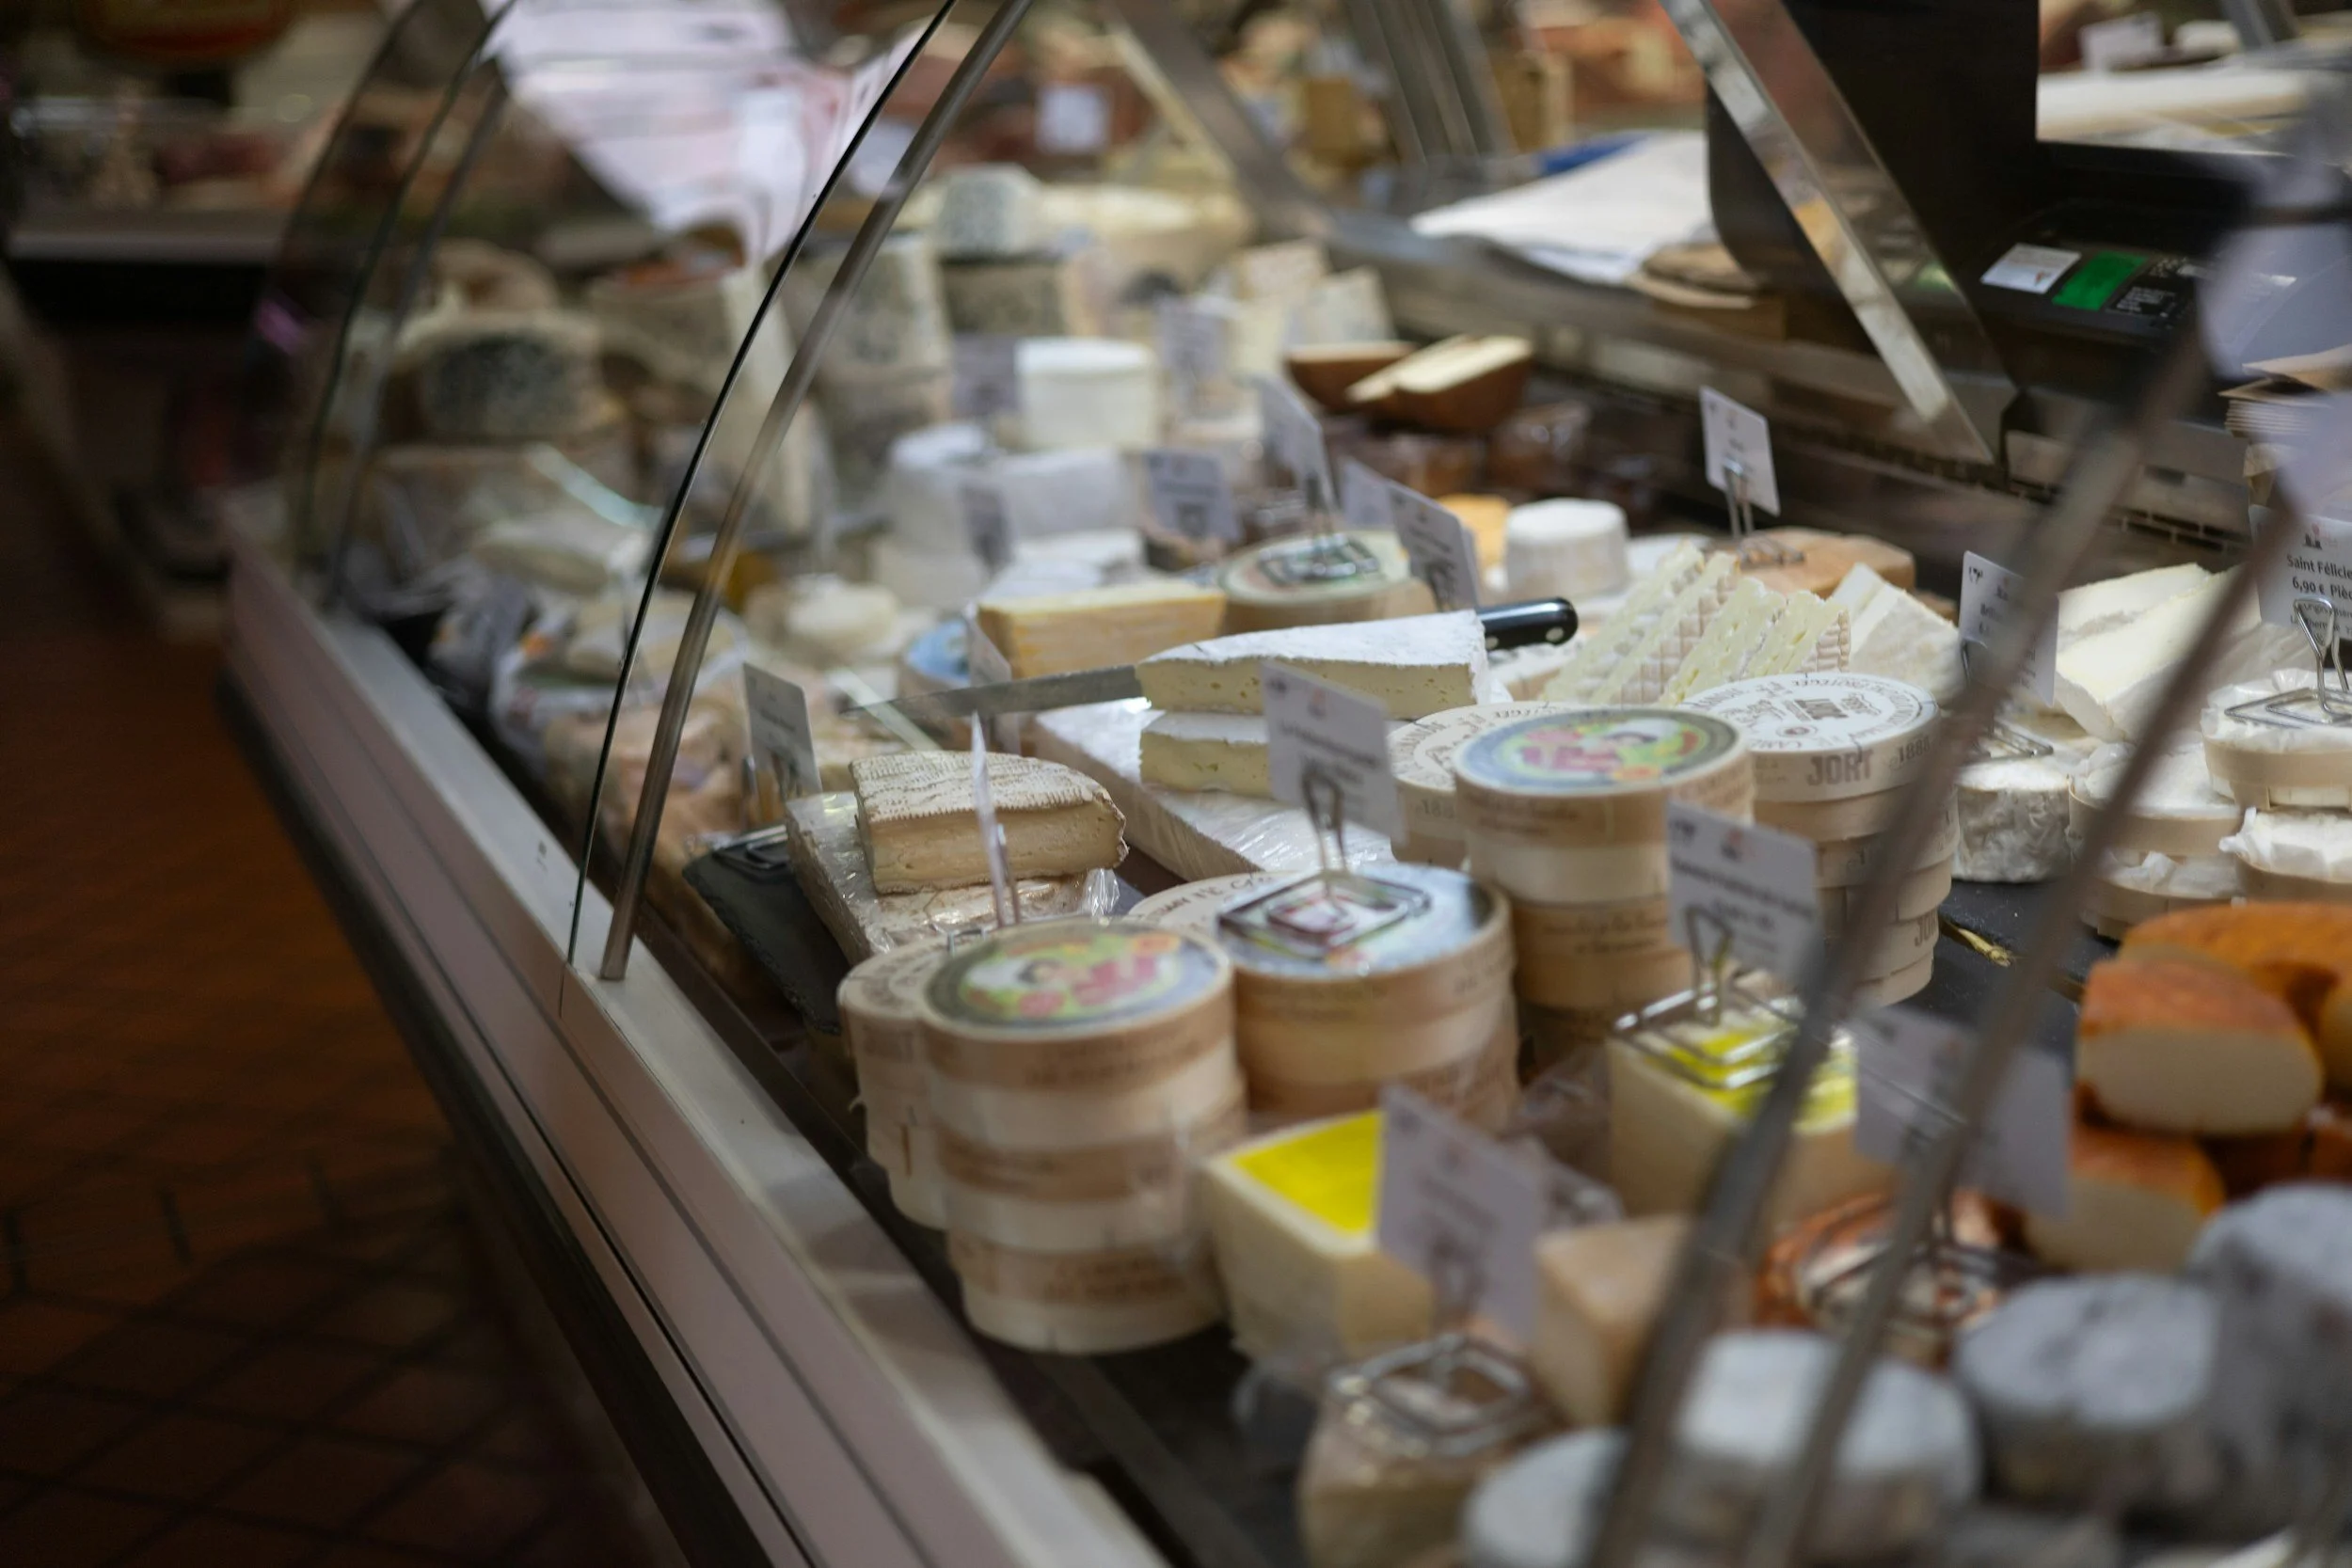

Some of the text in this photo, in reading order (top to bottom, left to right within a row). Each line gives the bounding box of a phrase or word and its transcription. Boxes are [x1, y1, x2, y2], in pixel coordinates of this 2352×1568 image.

[2287, 554, 2314, 573] Saint
[2292, 576, 2316, 594] 6,90
[1806, 748, 1874, 786] JORT
